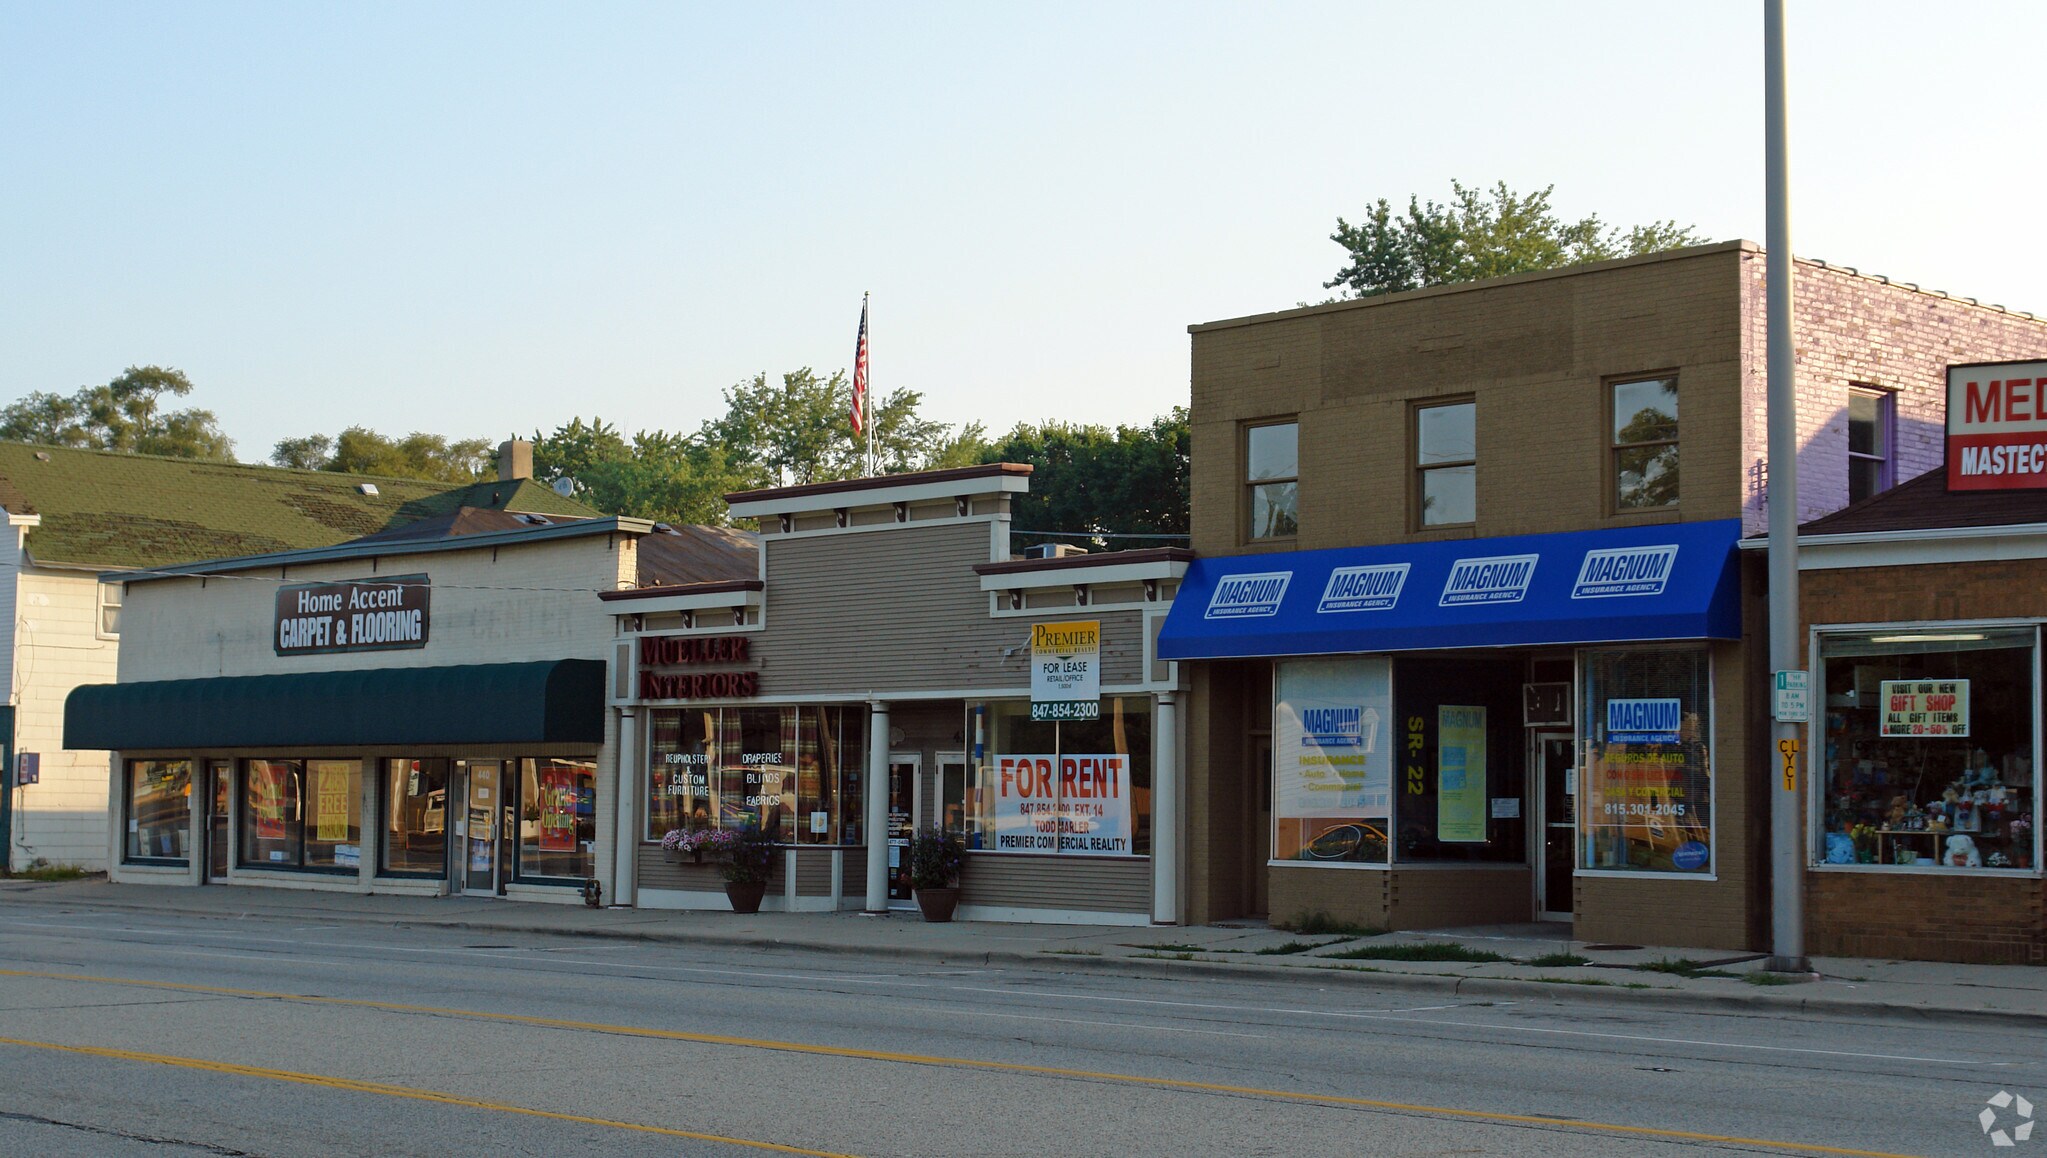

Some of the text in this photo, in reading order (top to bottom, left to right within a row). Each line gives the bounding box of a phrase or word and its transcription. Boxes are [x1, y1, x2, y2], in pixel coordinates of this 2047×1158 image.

[1961, 443, 2047, 475] MASTEC
[1583, 552, 1670, 582] MAGNUM
[1450, 561, 1531, 591] MAGNUM
[1328, 570, 1403, 598] MAGNUM
[1581, 582, 1657, 595] INSURANCE AGENCY
[1215, 578, 1286, 605] MAGNUM
[1448, 591, 1518, 602] INSURANCE AGENCY
[298, 585, 403, 614] Home Accent
[1363, 599, 1389, 607] AGENCY
[1213, 606, 1272, 615] INSURANCE AGENCY
[280, 608, 421, 649] CARPET & FLOORING
[1035, 624, 1096, 647] PREMIER
[640, 635, 749, 665] MUELLER
[1035, 647, 1071, 655] COMMERCIAL
[1043, 661, 1087, 673] FOR LEASE
[639, 671, 760, 699] INTERIORS
[1046, 674, 1083, 683] RETAIL/OFFICE
[1892, 683, 1956, 694] VISIT OUR NEW
[1890, 694, 1956, 712] GIFT SHOP
[1032, 702, 1099, 718] 847-854-2300
[1610, 702, 1678, 730] MAGNUM
[1303, 708, 1359, 734] MAGNUM
[1442, 710, 1482, 729] MAGNUM
[1888, 712, 1958, 723] ALL GIFT ITEMS
[1952, 723, 1966, 735] OFF
[742, 752, 782, 764] DRAPERIES
[1299, 755, 1366, 766] INSURANCE
[1604, 752, 1685, 764] SEGUROS DE AUTO
[478, 770, 490, 780] 440
[686, 766, 692, 774] &
[1304, 769, 1366, 778] Auto Home
[672, 774, 705, 785] CUSTOM
[746, 773, 780, 784] BLINDS
[1000, 758, 1122, 799] FOR RENT
[1408, 766, 1424, 795] 22
[667, 785, 709, 797] FURNITURE
[1308, 782, 1363, 792] Commercial
[1635, 786, 1685, 797] COMERCIAL
[320, 794, 347, 814] FREE
[746, 795, 780, 806] FABRICS
[1020, 802, 1103, 817] 847.854.200 EXT. 14
[1604, 802, 1685, 816] 815.301.2045
[542, 808, 574, 835] Opening
[1034, 820, 1056, 833] TODD
[1000, 835, 1127, 851] PREMIER COMERCIAL REALITY
